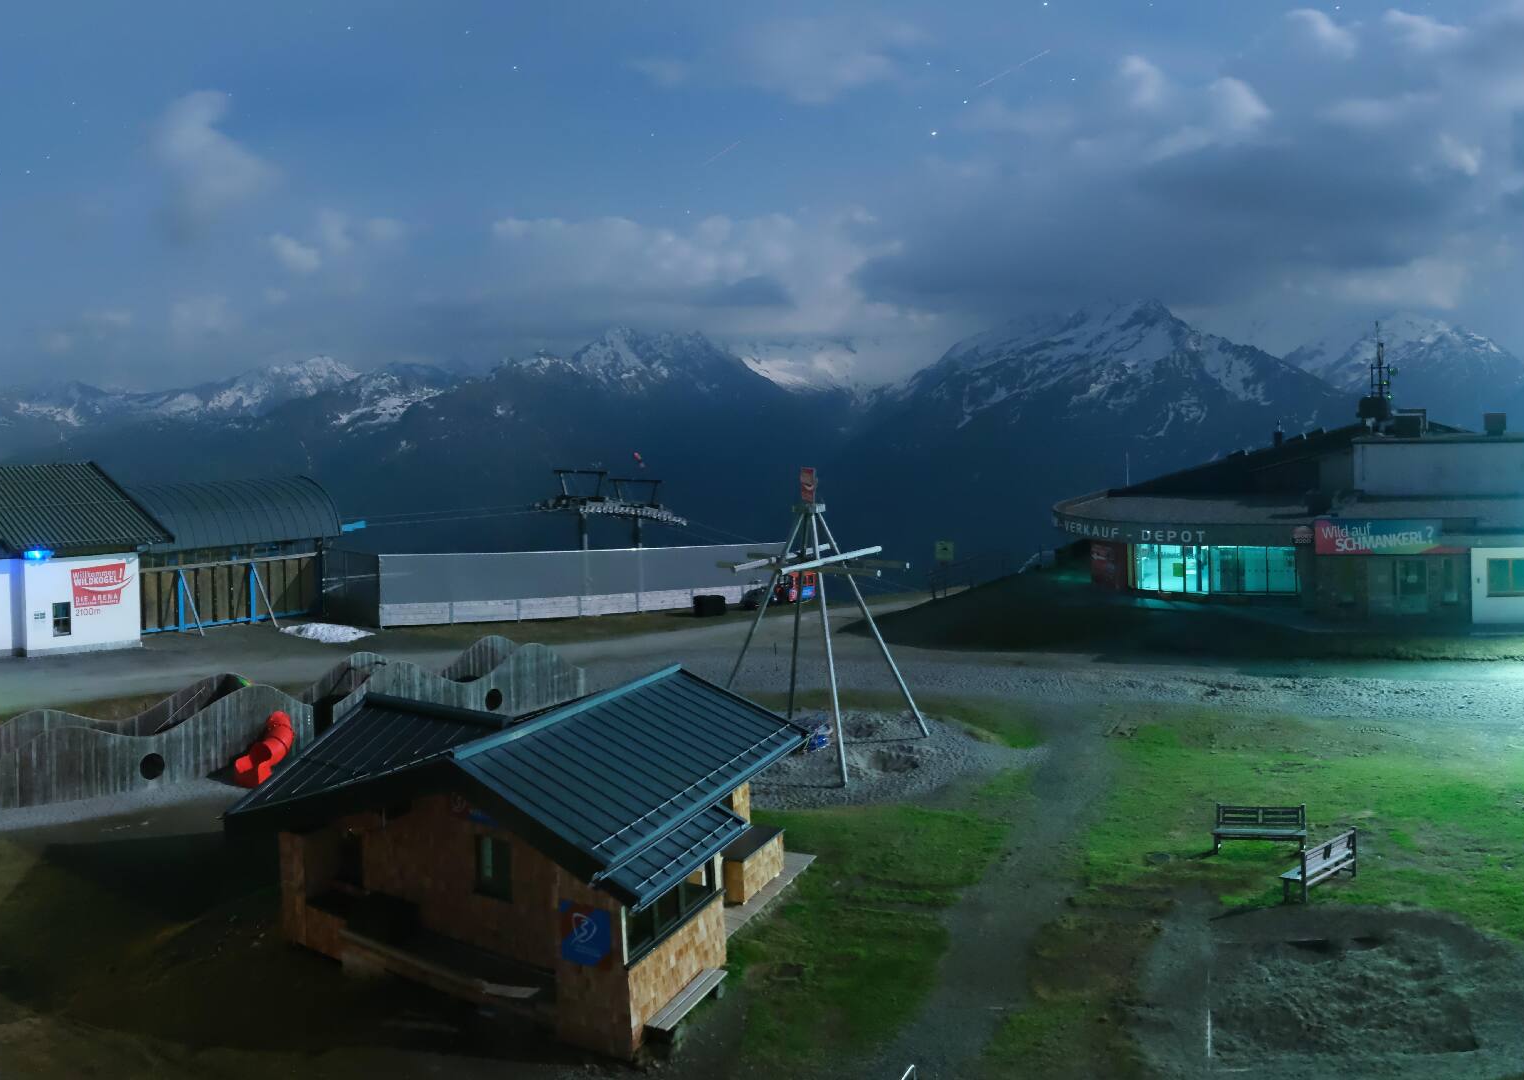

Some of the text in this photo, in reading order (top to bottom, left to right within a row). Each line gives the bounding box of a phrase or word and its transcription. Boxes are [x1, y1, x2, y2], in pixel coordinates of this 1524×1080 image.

[1064, 520, 1119, 539] VERKAUF
[1141, 529, 1206, 543] DEPOT
[1321, 522, 1372, 539] Wild auf
[72, 570, 116, 580] Willkommen
